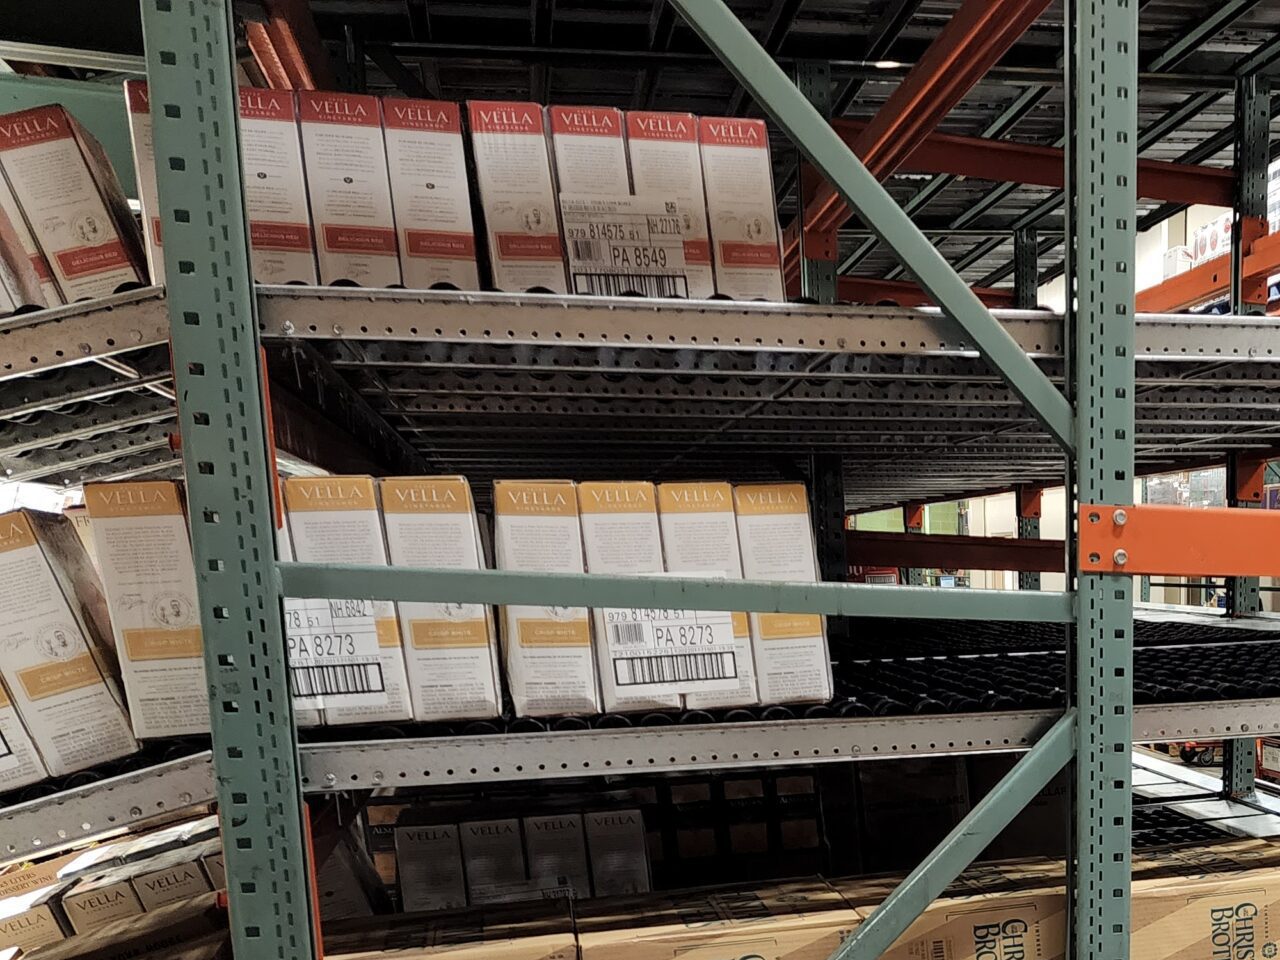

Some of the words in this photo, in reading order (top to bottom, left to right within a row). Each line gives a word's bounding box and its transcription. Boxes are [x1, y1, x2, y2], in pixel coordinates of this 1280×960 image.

[239, 95, 281, 110] ELLA
[310, 99, 367, 116] VELLA
[394, 106, 450, 123] VELLA
[480, 110, 533, 125] VELLA
[561, 112, 613, 127] VELLA
[0, 117, 59, 138] VELLA
[636, 118, 687, 133] VELLA
[708, 123, 758, 139] VELLA
[568, 228, 587, 238] 979
[589, 223, 625, 240] 814575
[612, 247, 631, 267] PA
[634, 247, 667, 268] 8549
[99, 490, 167, 504] VELLA
[300, 485, 364, 498] VELLA
[395, 488, 457, 502] VELLA
[508, 491, 567, 505] VELLA
[591, 490, 648, 502] VELLA
[671, 489, 725, 501] VELLA
[746, 491, 798, 504] VELLA
[656, 627, 675, 647] PA
[678, 624, 714, 646] 8273
[287, 637, 310, 658] PA
[314, 634, 356, 656] 8273
[533, 819, 576, 832] VELLA
[594, 814, 636, 827] VELLA
[406, 829, 450, 842] VELLA
[470, 824, 513, 837] VELLA
[145, 870, 195, 892] VELLA
[75, 890, 126, 912] VELLA
[0, 912, 48, 935] VELLA
